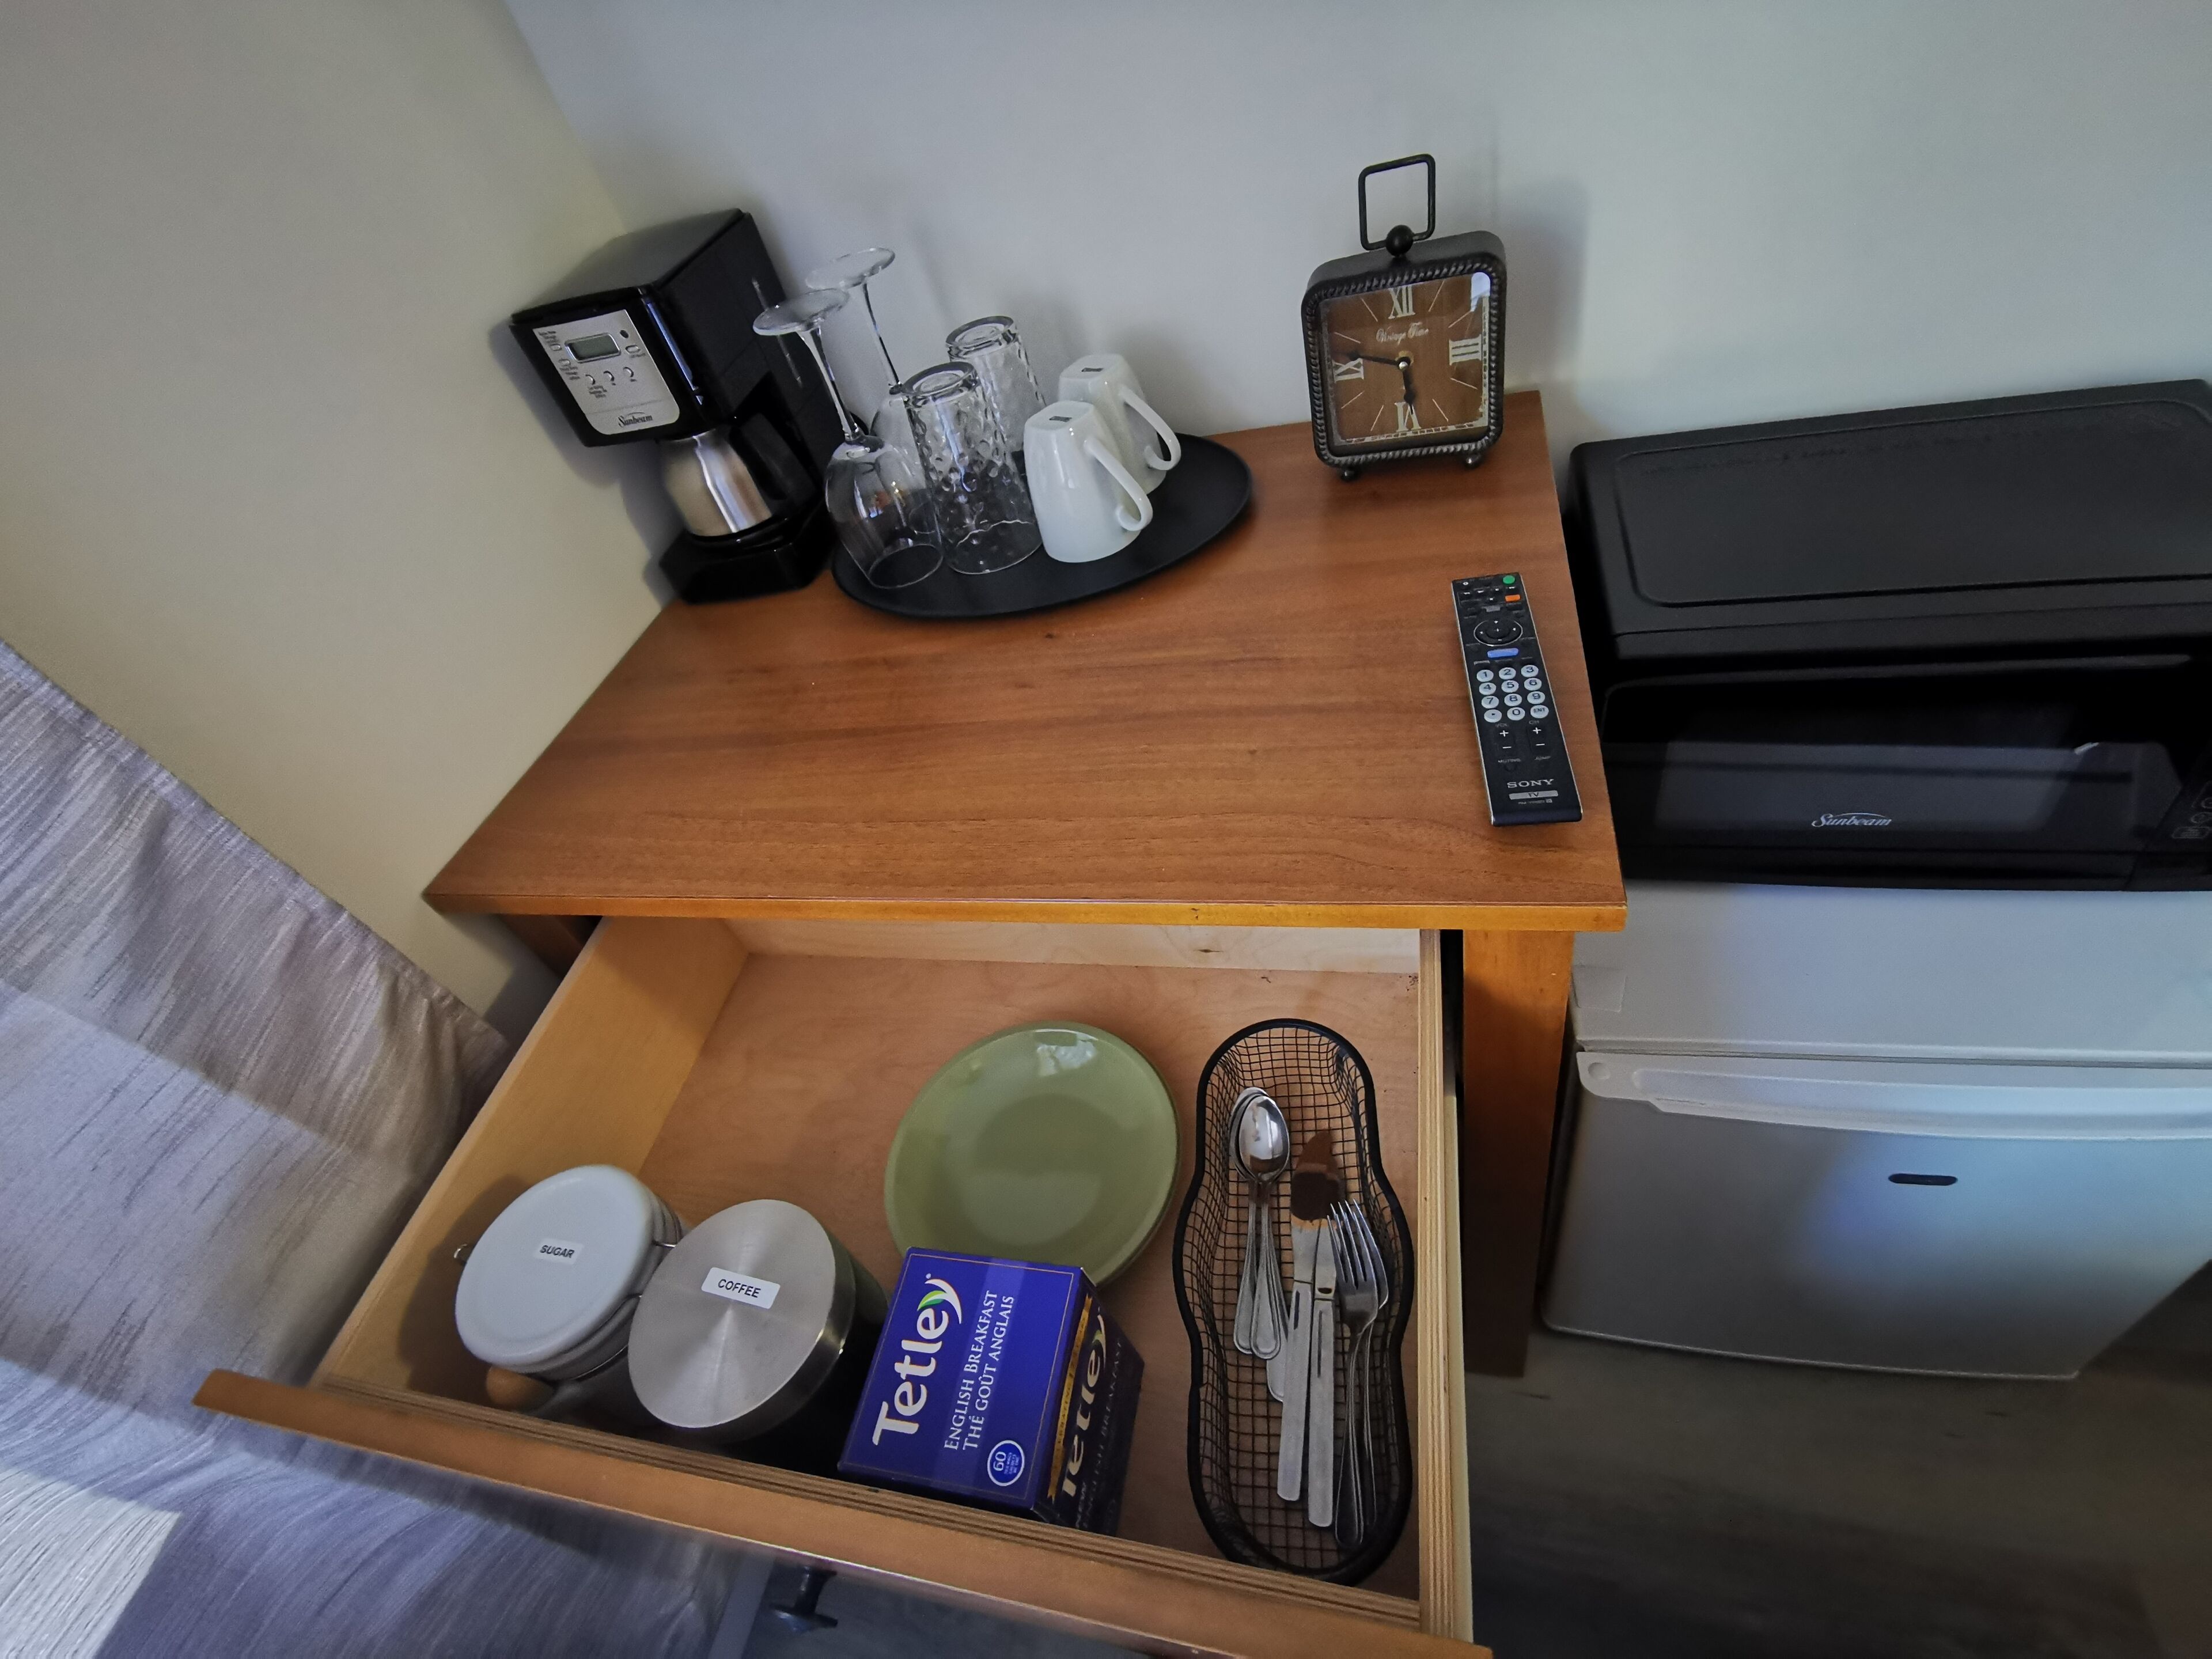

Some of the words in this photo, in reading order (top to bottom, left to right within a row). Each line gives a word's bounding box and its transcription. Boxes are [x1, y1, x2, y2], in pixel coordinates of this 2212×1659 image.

[618, 413, 653, 428] Sunbeam
[1507, 779, 1554, 789] SONY
[1812, 813, 1892, 828] Sunbeam
[539, 1244, 575, 1259] SUGAR
[717, 1278, 762, 1298] COFFEE
[872, 1278, 963, 1446] Tetley
[944, 1378, 976, 1450] ENGLISH
[963, 1290, 998, 1374] BREAKFAST
[962, 1414, 984, 1450] THÉ
[975, 1363, 998, 1412] GOÛT
[988, 1295, 1015, 1362] ANGLAIS
[992, 1450, 1006, 1472] 60
